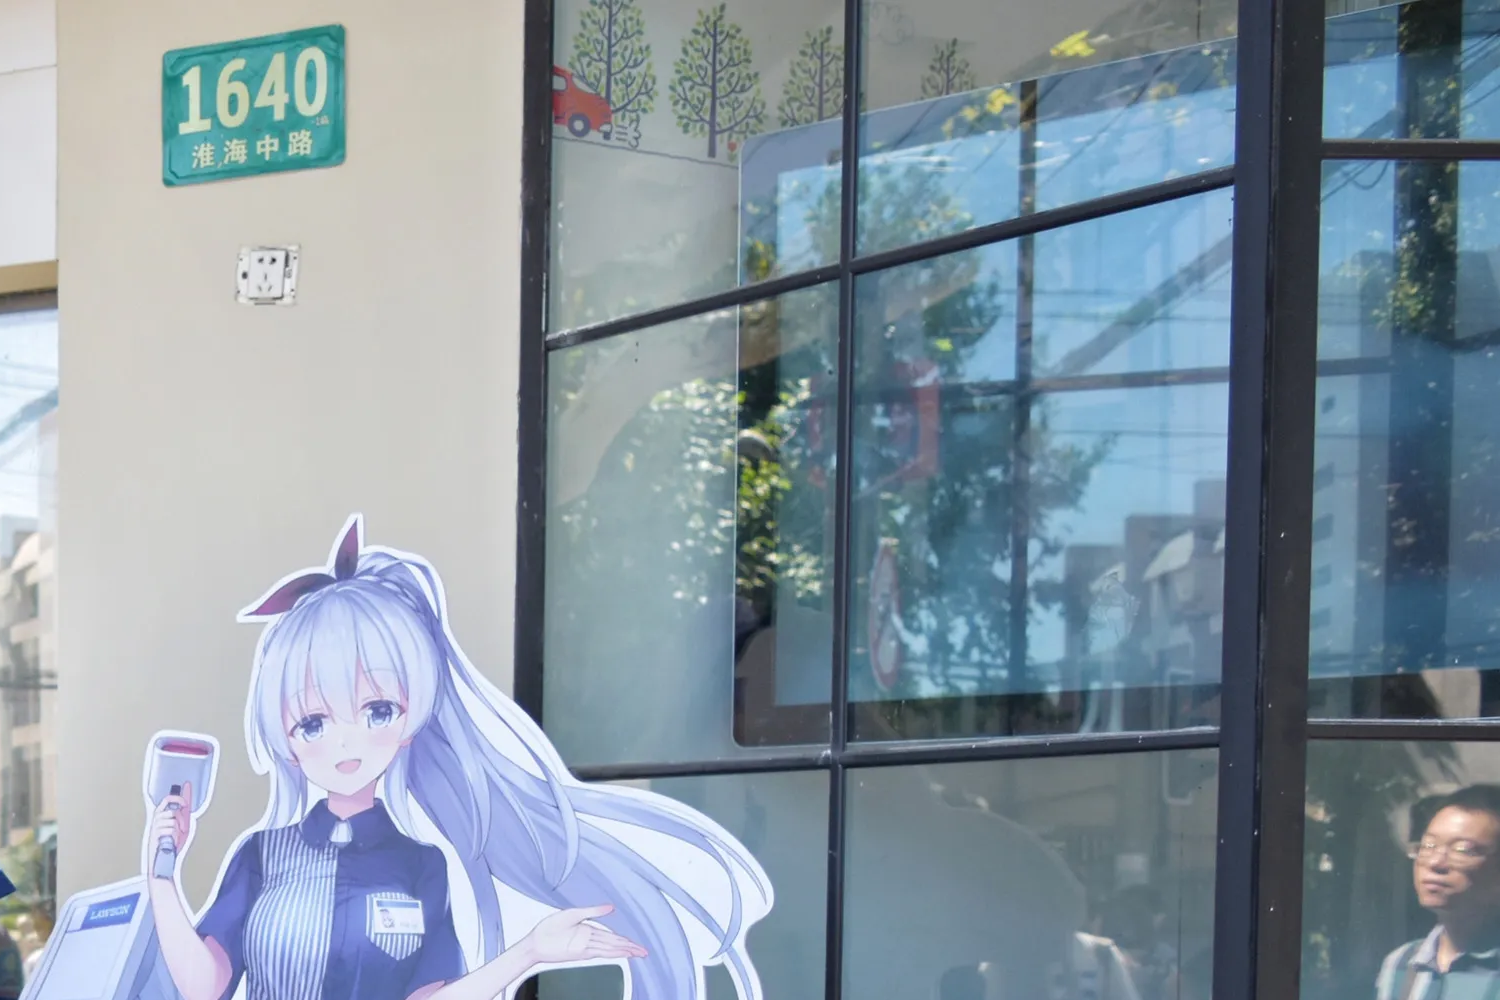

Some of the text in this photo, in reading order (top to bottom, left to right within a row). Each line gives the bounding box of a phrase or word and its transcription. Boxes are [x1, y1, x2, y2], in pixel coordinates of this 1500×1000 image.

[179, 46, 328, 135] 1640
[191, 129, 314, 169] 淮海中路
